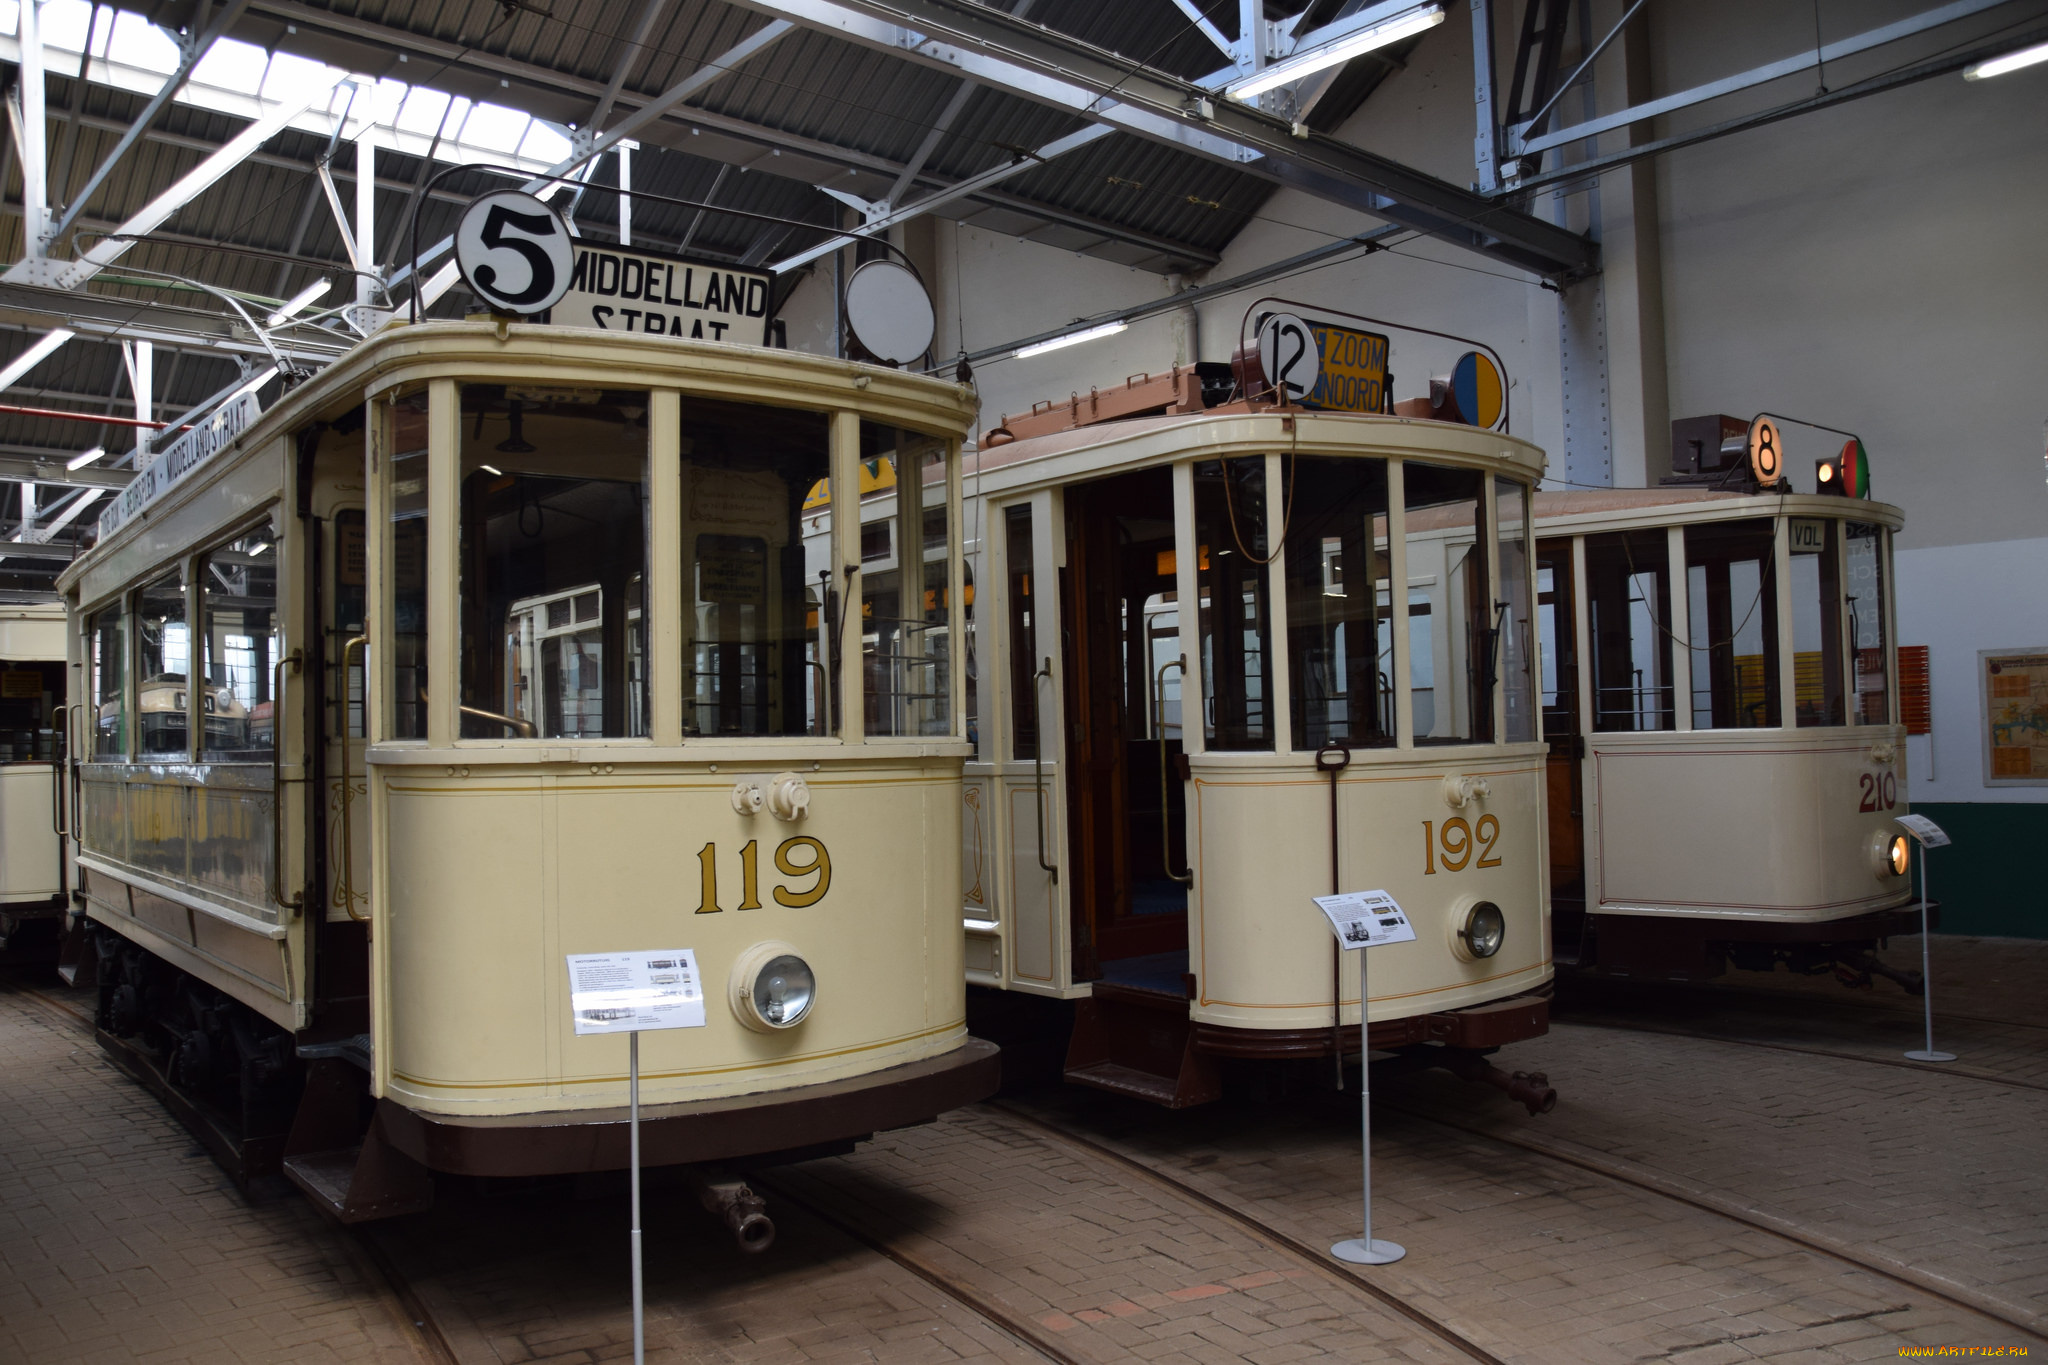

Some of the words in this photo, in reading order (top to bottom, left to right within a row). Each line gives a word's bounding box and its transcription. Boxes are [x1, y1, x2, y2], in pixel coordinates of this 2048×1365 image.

[473, 204, 557, 306] 5
[1271, 320, 1304, 395] 12
[1330, 331, 1385, 373] ZOOM
[1758, 424, 1776, 476] 8
[1795, 525, 1822, 546] VOL
[1859, 771, 1896, 813] 210
[1422, 814, 1502, 875] 192
[694, 835, 832, 914] 119
